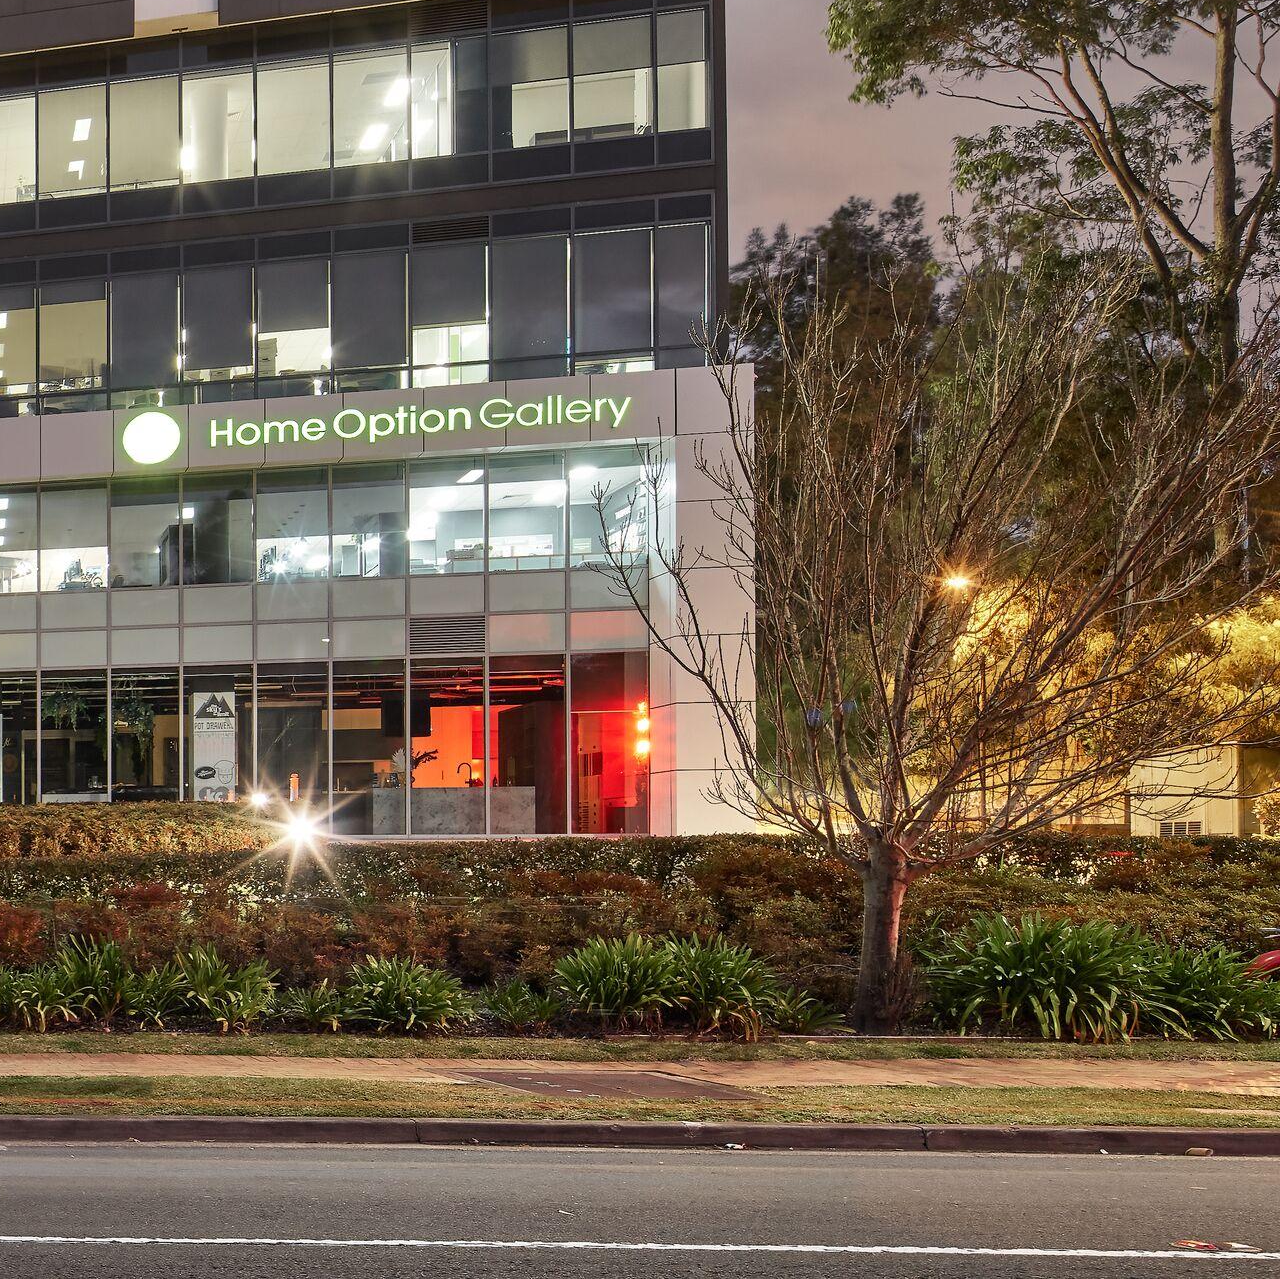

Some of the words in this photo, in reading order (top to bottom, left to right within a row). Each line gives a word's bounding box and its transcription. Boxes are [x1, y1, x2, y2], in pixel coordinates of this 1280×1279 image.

[210, 417, 326, 447] Home
[332, 405, 472, 443] Option
[479, 394, 632, 429] Gallery
